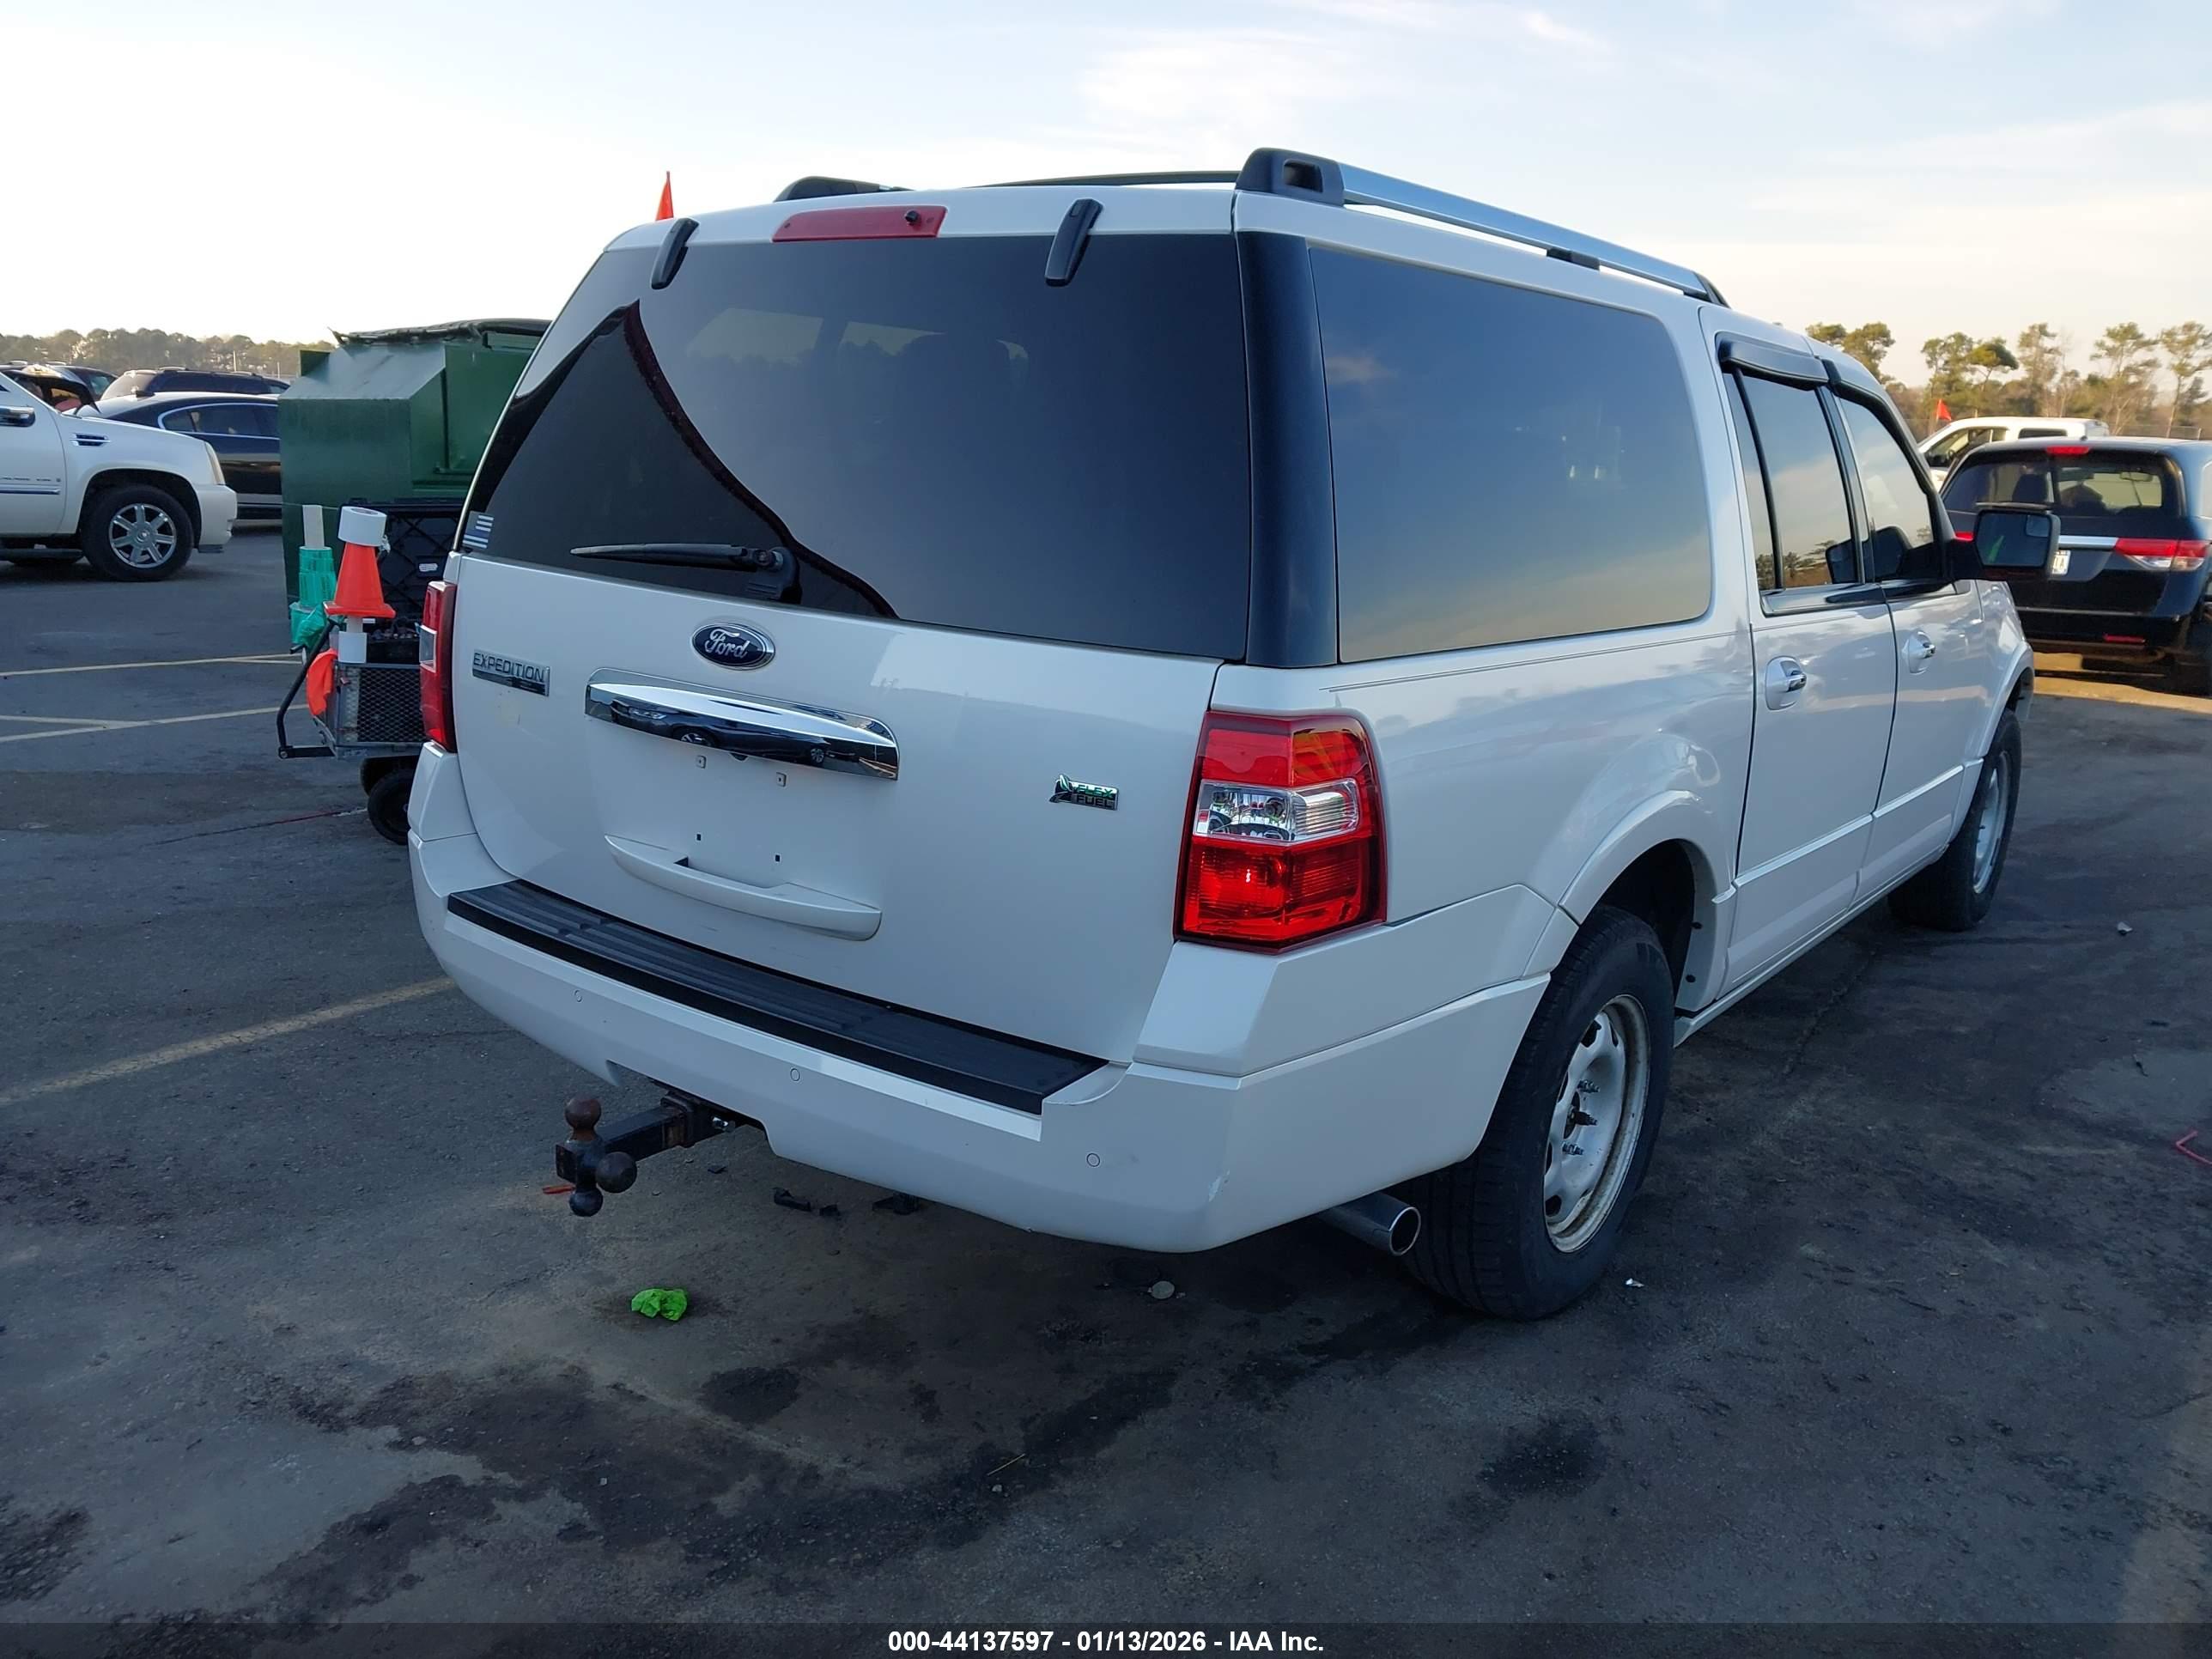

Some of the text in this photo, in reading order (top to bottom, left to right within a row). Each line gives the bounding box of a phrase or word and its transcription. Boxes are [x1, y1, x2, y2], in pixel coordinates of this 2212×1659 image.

[704, 629, 750, 659] Ford
[473, 652, 544, 684] EXPEDITION
[1076, 794, 1113, 809] FUEL
[1077, 784, 1114, 799] FLEX
